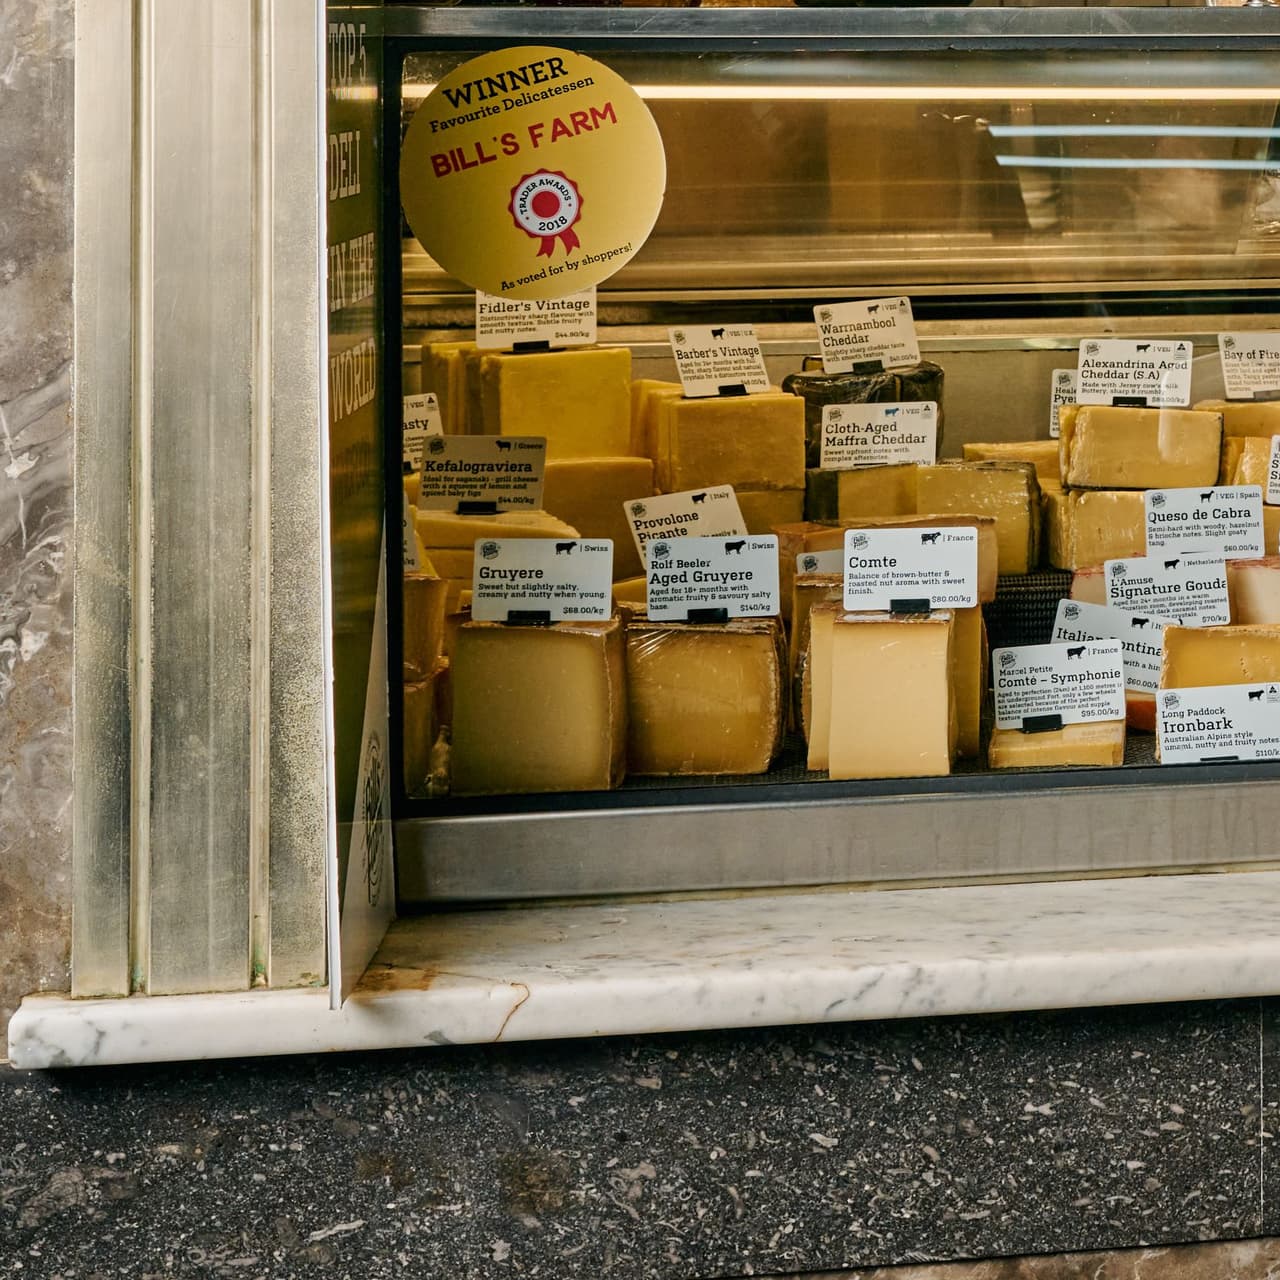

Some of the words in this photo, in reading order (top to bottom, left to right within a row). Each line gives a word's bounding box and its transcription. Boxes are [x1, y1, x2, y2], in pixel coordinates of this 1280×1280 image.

[329, 23, 356, 84] TOP
[442, 57, 569, 109] WINNER
[429, 104, 501, 133] Favourite
[503, 76, 595, 111] Delicatessen
[430, 133, 520, 178] BILL'S
[528, 102, 617, 147] FARM
[329, 130, 361, 201] DELI
[519, 183, 538, 215] TRADER
[539, 178, 572, 201] AWARDS
[538, 215, 568, 231] 2018
[330, 243, 347, 313] IN
[351, 232, 375, 306] THE
[501, 281, 516, 291] As
[518, 269, 547, 285] voted
[549, 264, 564, 276] for
[566, 260, 580, 272] by
[582, 243, 632, 267] shoppers!
[479, 302, 532, 313] Fidler's
[536, 299, 590, 312] Vintage
[820, 318, 896, 335] Warrnambool
[823, 334, 869, 347] Cheddar
[676, 348, 718, 360] Barber's
[719, 346, 760, 358] Vintage
[1224, 350, 1242, 360] Bay
[1247, 351, 1256, 359] of
[1082, 360, 1155, 369] Alexandrina
[1159, 361, 1187, 370] Aged
[331, 337, 376, 423] WORLD
[1081, 370, 1130, 379] Cheddar
[825, 422, 897, 434] Cloth-Aged
[825, 435, 868, 446] Maffra
[872, 434, 927, 445] Cheddar
[425, 461, 532, 473] Kefalograviera
[633, 511, 699, 531] Provolone
[1148, 510, 1188, 522] Queso
[1193, 510, 1208, 520] de
[1213, 508, 1251, 519] Cabra
[638, 526, 688, 543] Picante
[651, 561, 672, 569] Rolf
[676, 559, 711, 569] Beeler
[849, 556, 897, 568] Comte
[479, 567, 544, 581] Gruyere
[649, 571, 688, 586] Aged
[692, 569, 753, 585] Gruyere
[1112, 577, 1153, 586] L'Amuse
[1111, 584, 1184, 599] Signature
[998, 677, 1037, 688] Comté
[1051, 669, 1120, 685] Symphonie
[1000, 668, 1027, 676] Marcel
[1162, 711, 1184, 719] Long
[1188, 707, 1225, 716] Paddock
[1163, 717, 1233, 733] Ironbark
